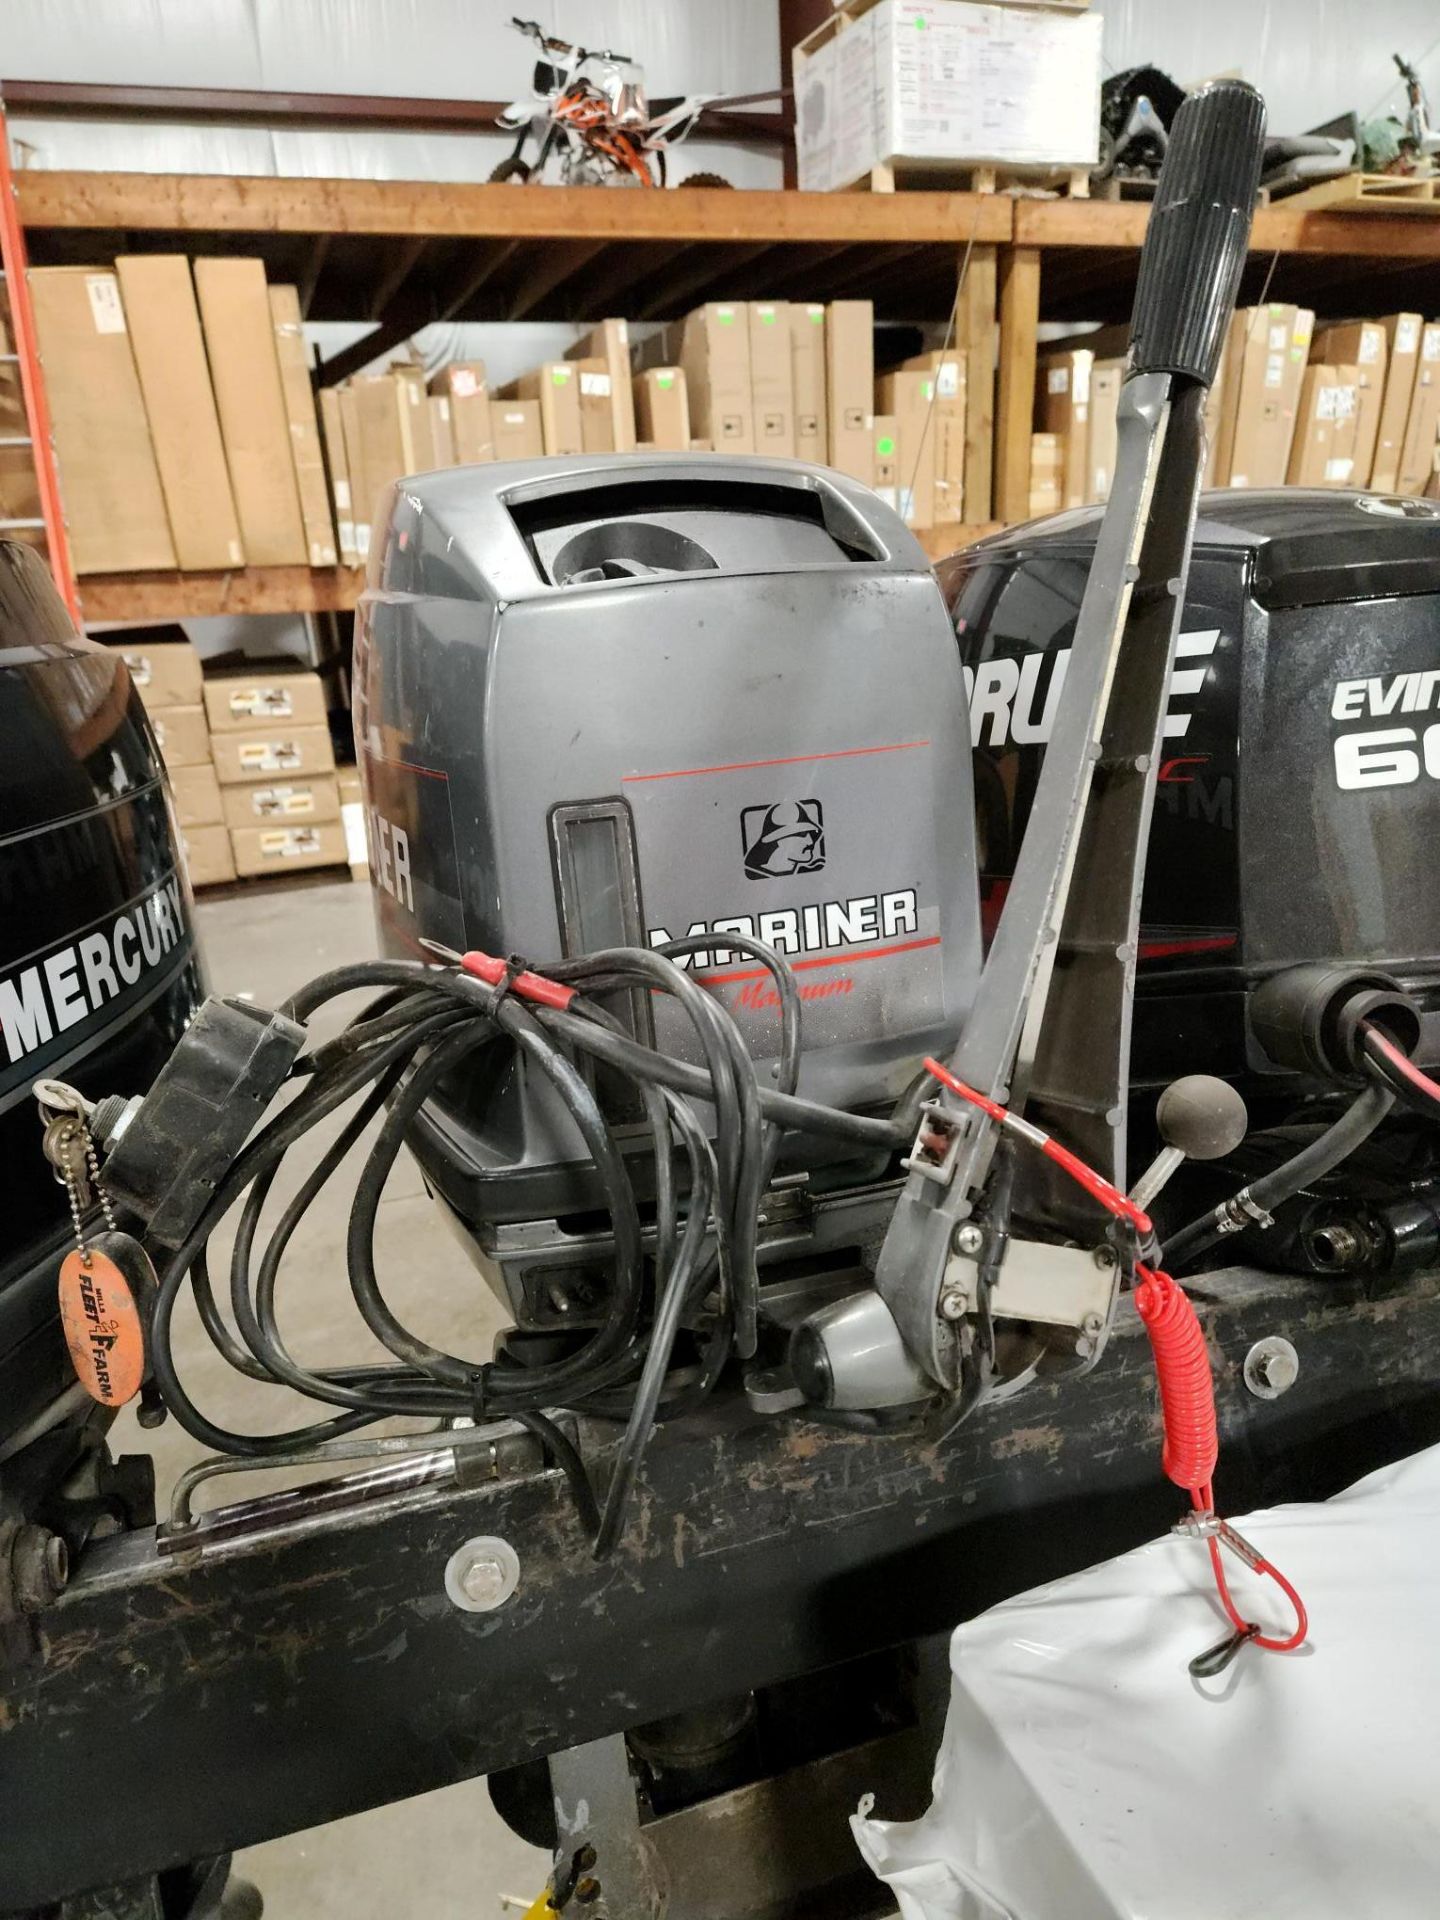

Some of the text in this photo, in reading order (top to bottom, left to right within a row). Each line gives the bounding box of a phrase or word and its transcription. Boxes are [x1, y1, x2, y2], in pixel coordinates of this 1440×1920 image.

[1334, 723, 1440, 790] 6
[648, 887, 918, 971] MARINER
[0, 873, 185, 1063] MERCURY
[733, 978, 854, 1018] Manum
[78, 1273, 100, 1324] FLEET
[92, 1348, 113, 1398] FARM
[95, 1287, 106, 1314] MILLS
